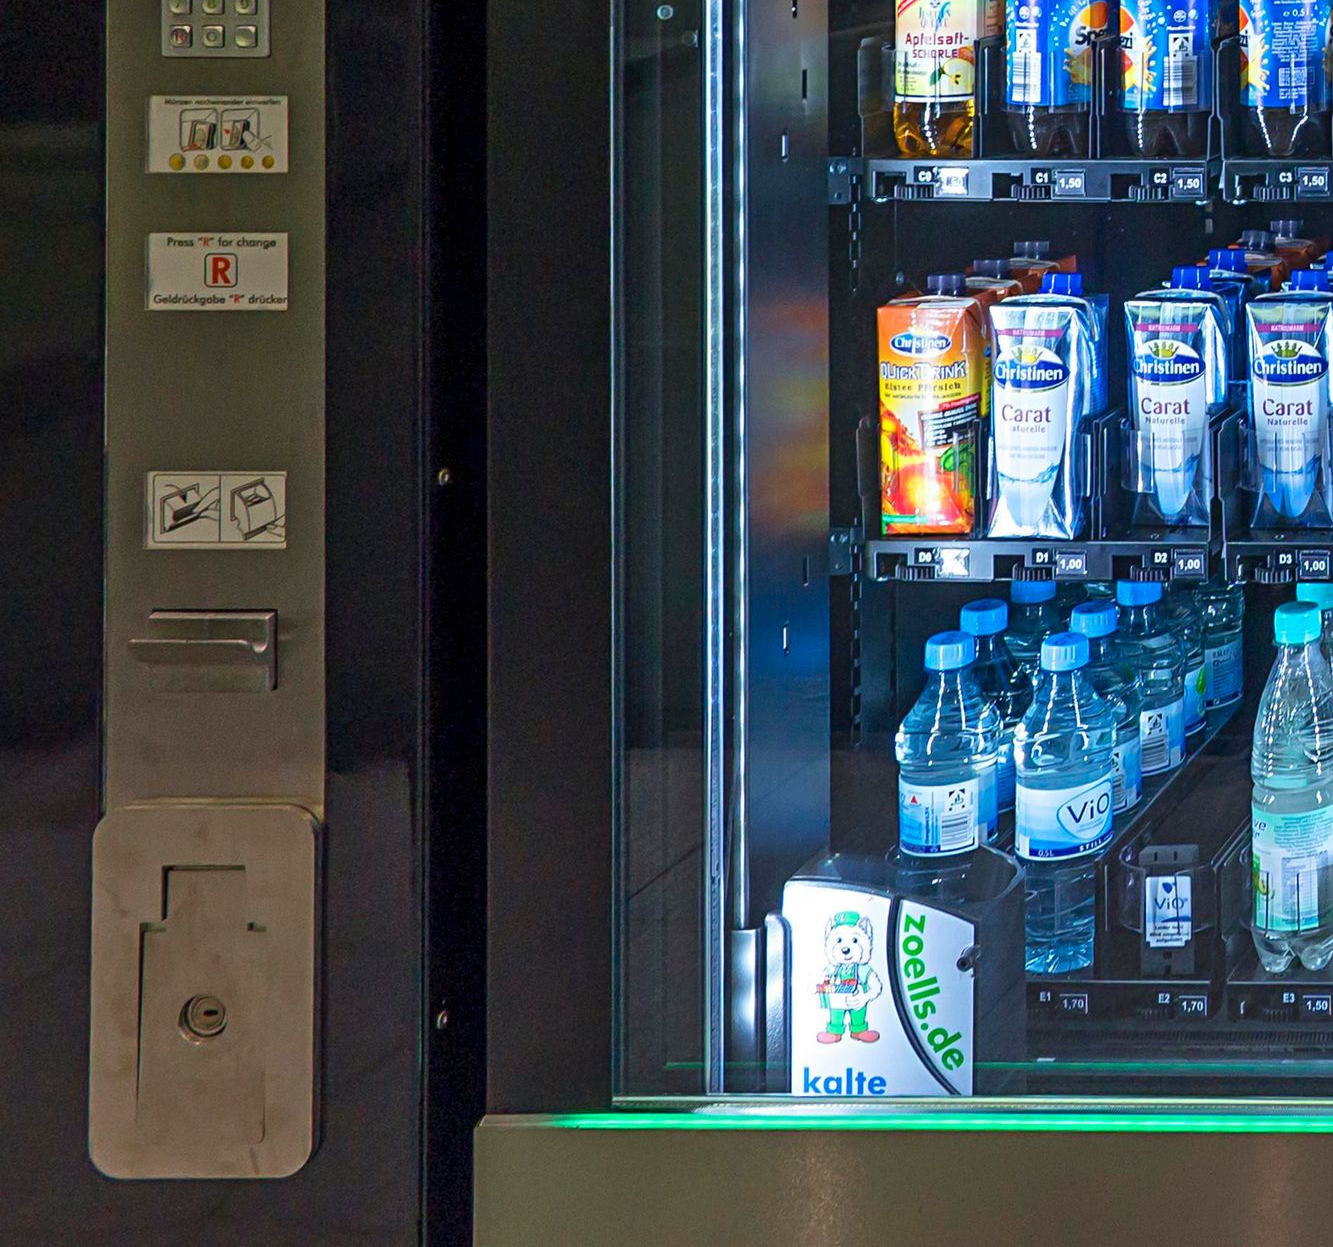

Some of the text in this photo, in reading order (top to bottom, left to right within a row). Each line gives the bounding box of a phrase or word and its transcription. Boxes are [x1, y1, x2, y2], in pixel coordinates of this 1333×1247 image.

[905, 32, 970, 46] Apfelsaft-
[1154, 173, 1200, 189] C2 1,50
[166, 237, 276, 250] Press for change
[212, 257, 231, 284] R
[996, 364, 1063, 381] Christinen
[1253, 358, 1322, 377] Christinen
[1262, 398, 1314, 418] Carat
[904, 914, 964, 1072] zoells.de
[804, 1067, 887, 1096] kalte
